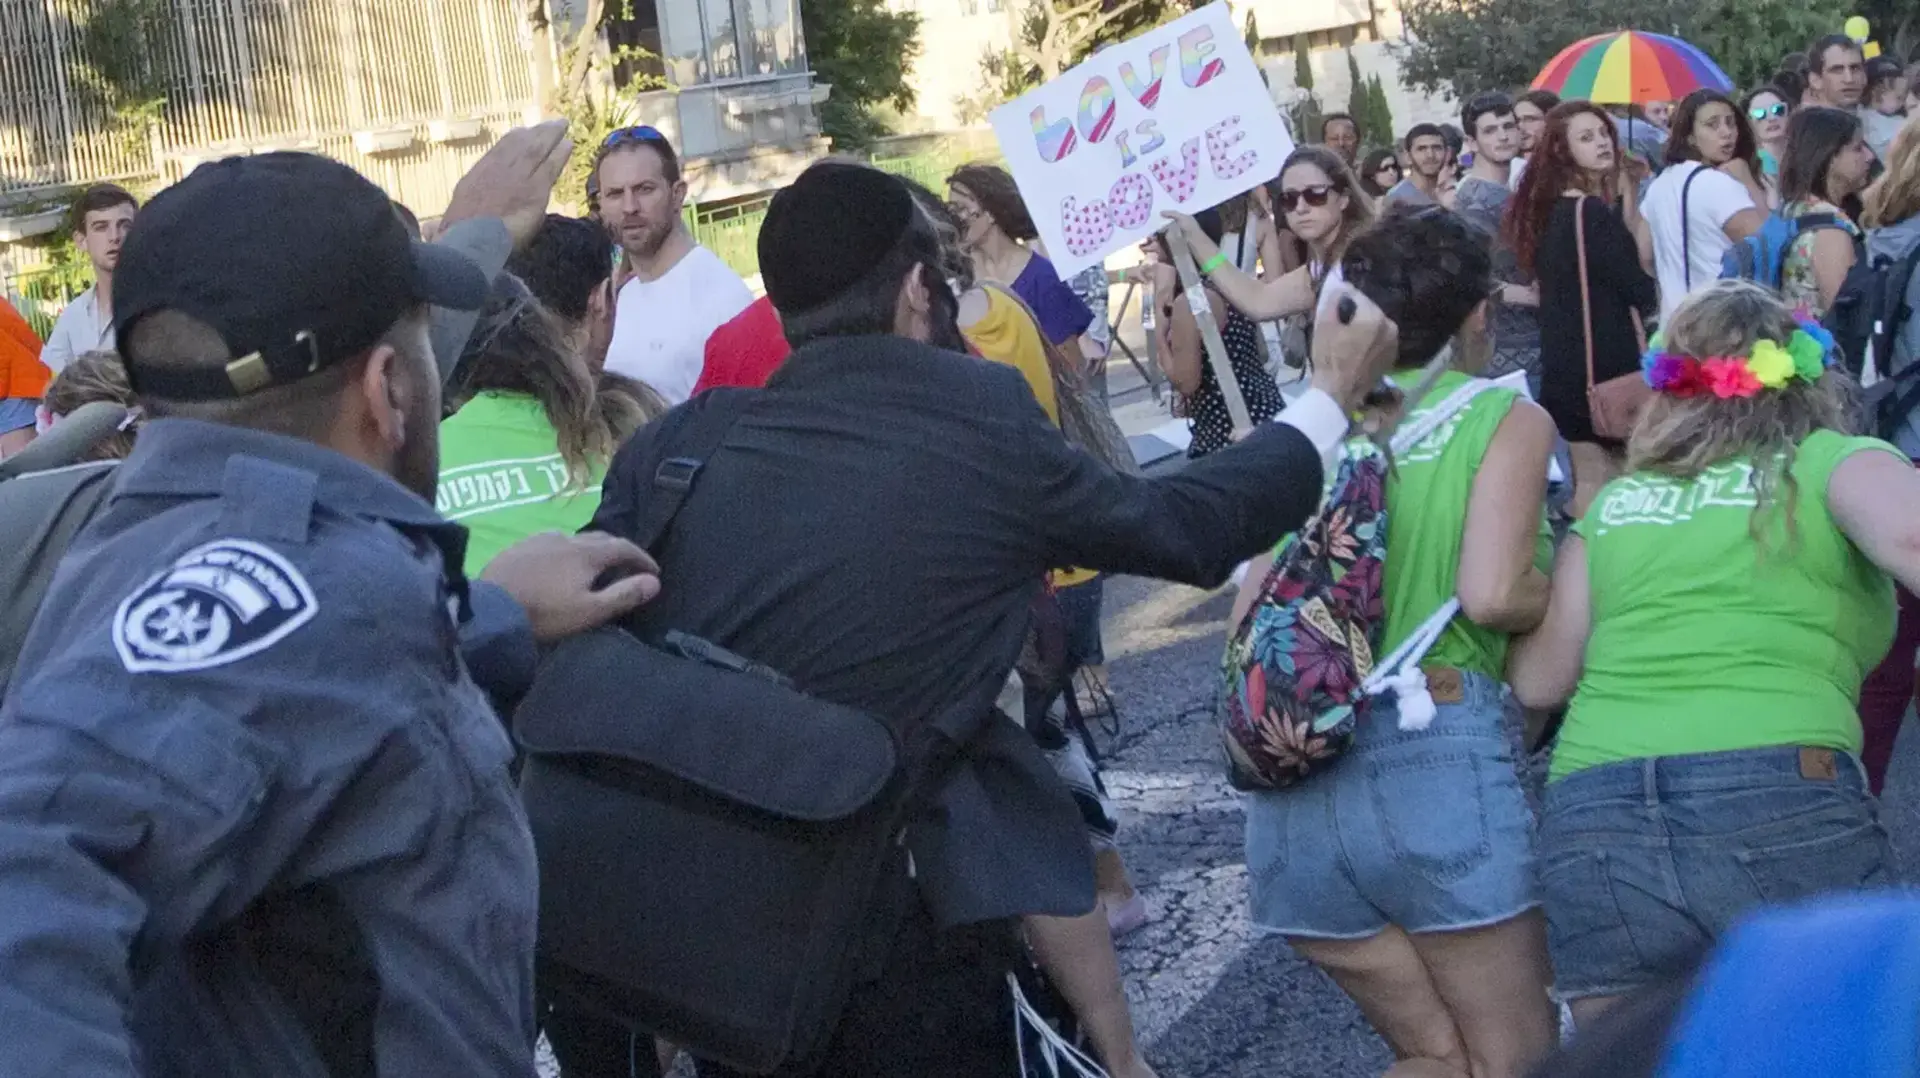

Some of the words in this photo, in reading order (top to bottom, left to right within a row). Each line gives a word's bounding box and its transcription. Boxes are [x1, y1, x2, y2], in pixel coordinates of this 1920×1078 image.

[1029, 23, 1226, 164] LOVE
[1114, 118, 1167, 169] IS
[1060, 115, 1259, 257] LOVE
